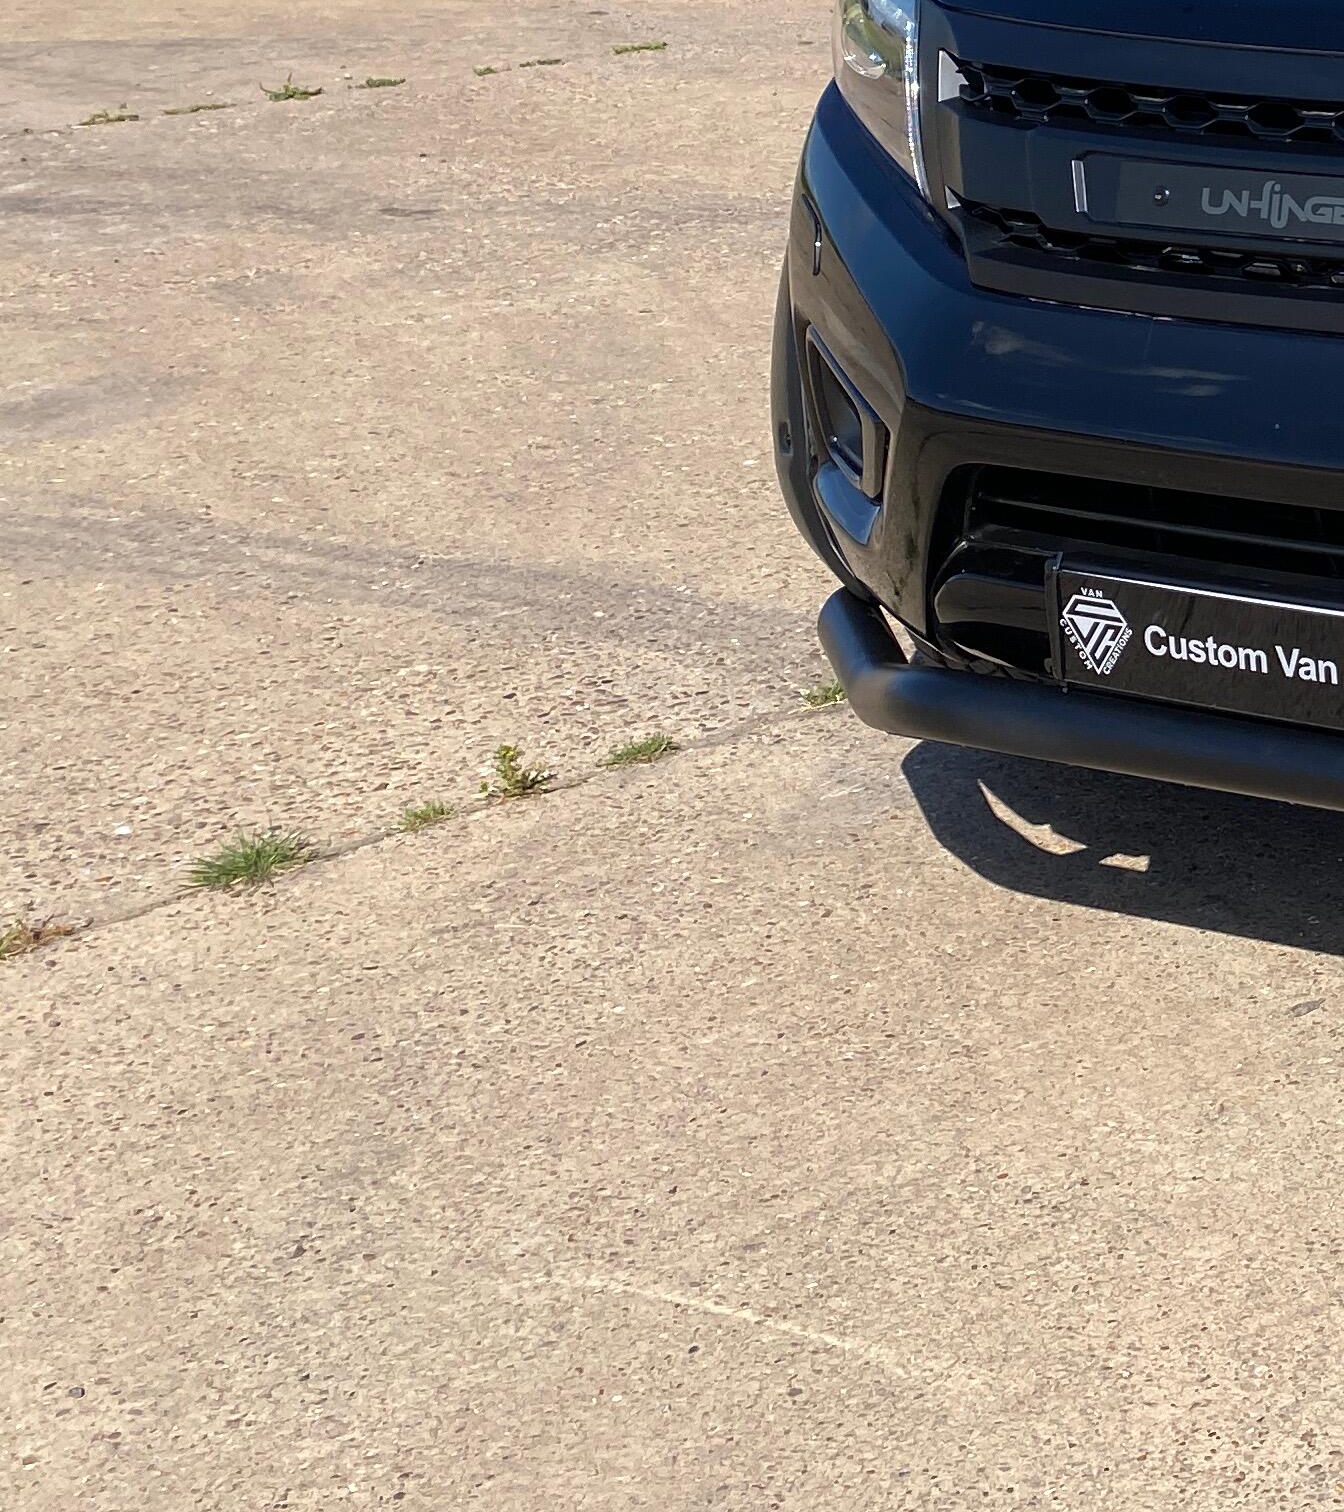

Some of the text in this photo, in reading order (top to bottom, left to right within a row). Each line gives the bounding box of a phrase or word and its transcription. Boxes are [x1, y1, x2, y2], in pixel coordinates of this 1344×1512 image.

[1080, 586, 1103, 598] VAN
[1059, 618, 1093, 670] CUSTOM
[1103, 627, 1133, 675] CREATIONS
[1143, 624, 1270, 675] Custom
[1276, 645, 1339, 686] Van
